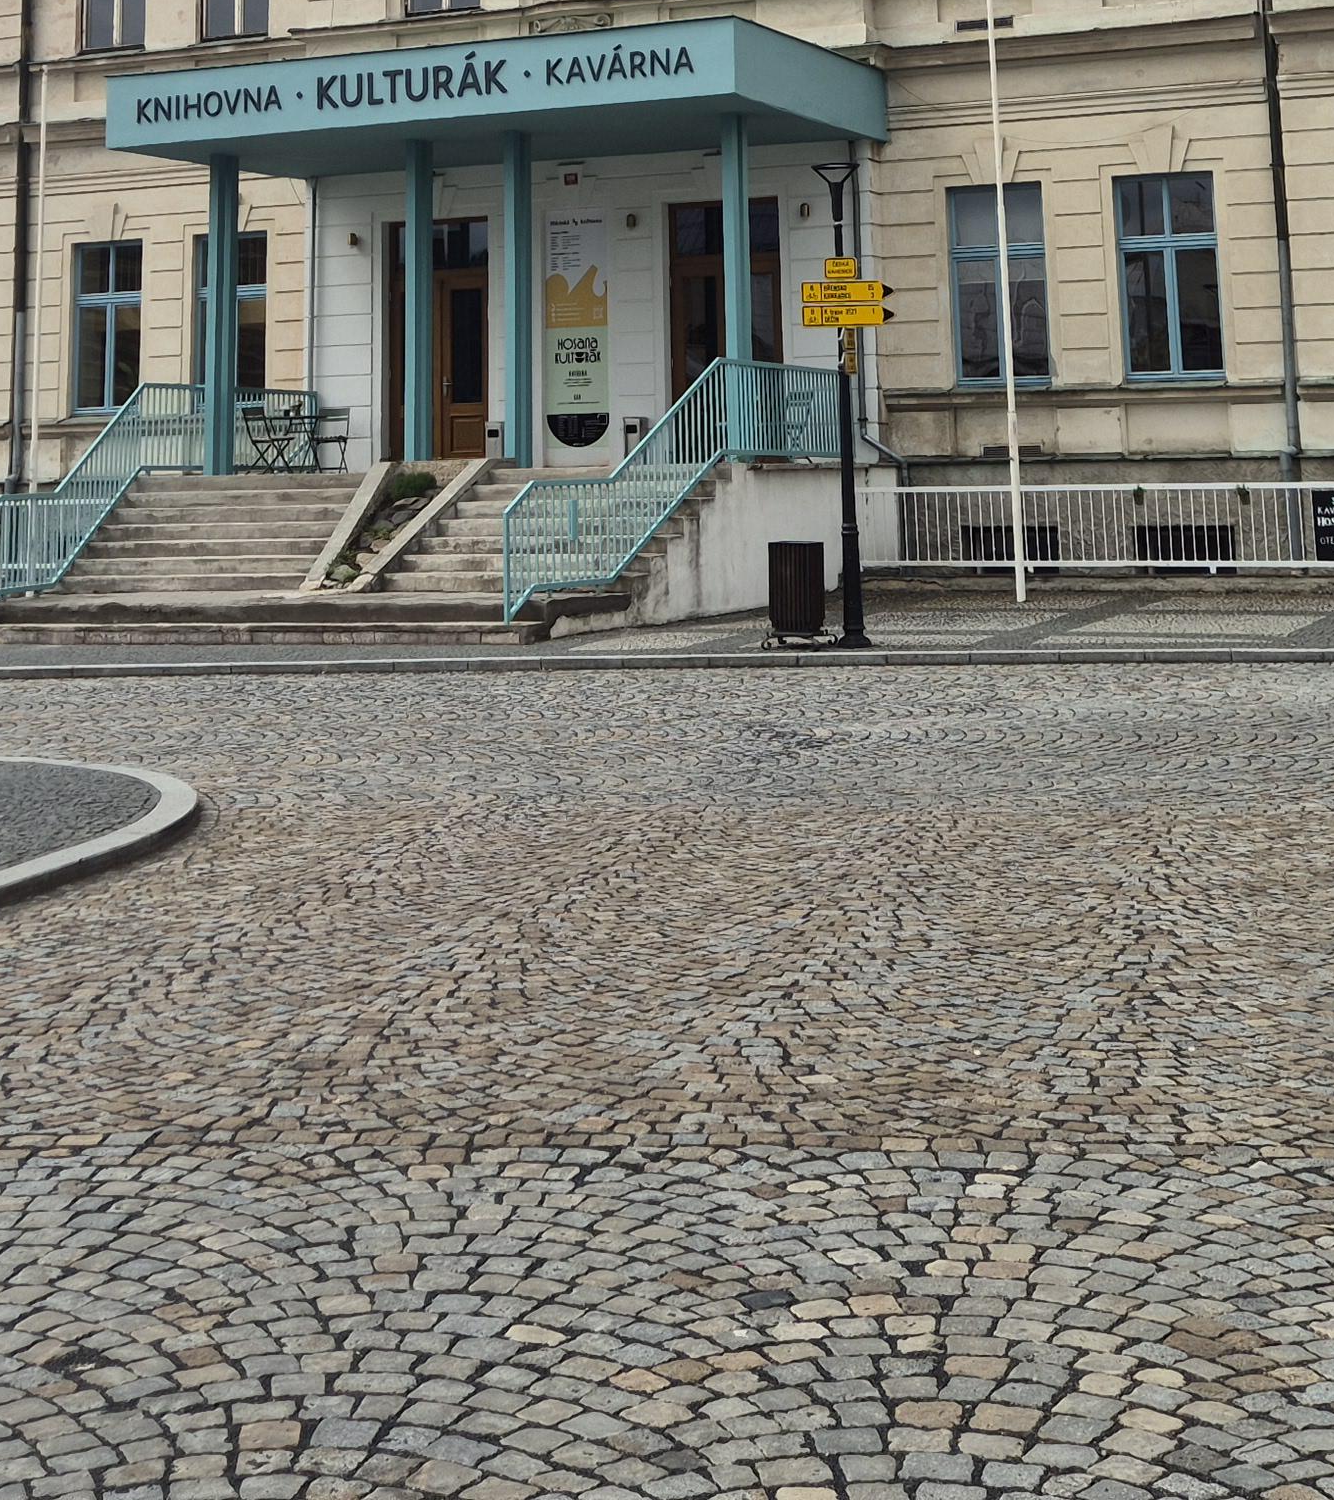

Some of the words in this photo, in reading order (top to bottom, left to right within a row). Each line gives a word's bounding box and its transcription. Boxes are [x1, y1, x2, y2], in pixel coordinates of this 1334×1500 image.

[136, 84, 283, 125] KNIHOVNA
[316, 50, 508, 111] KULTURÁK
[545, 43, 695, 87] KAVÁRNA
